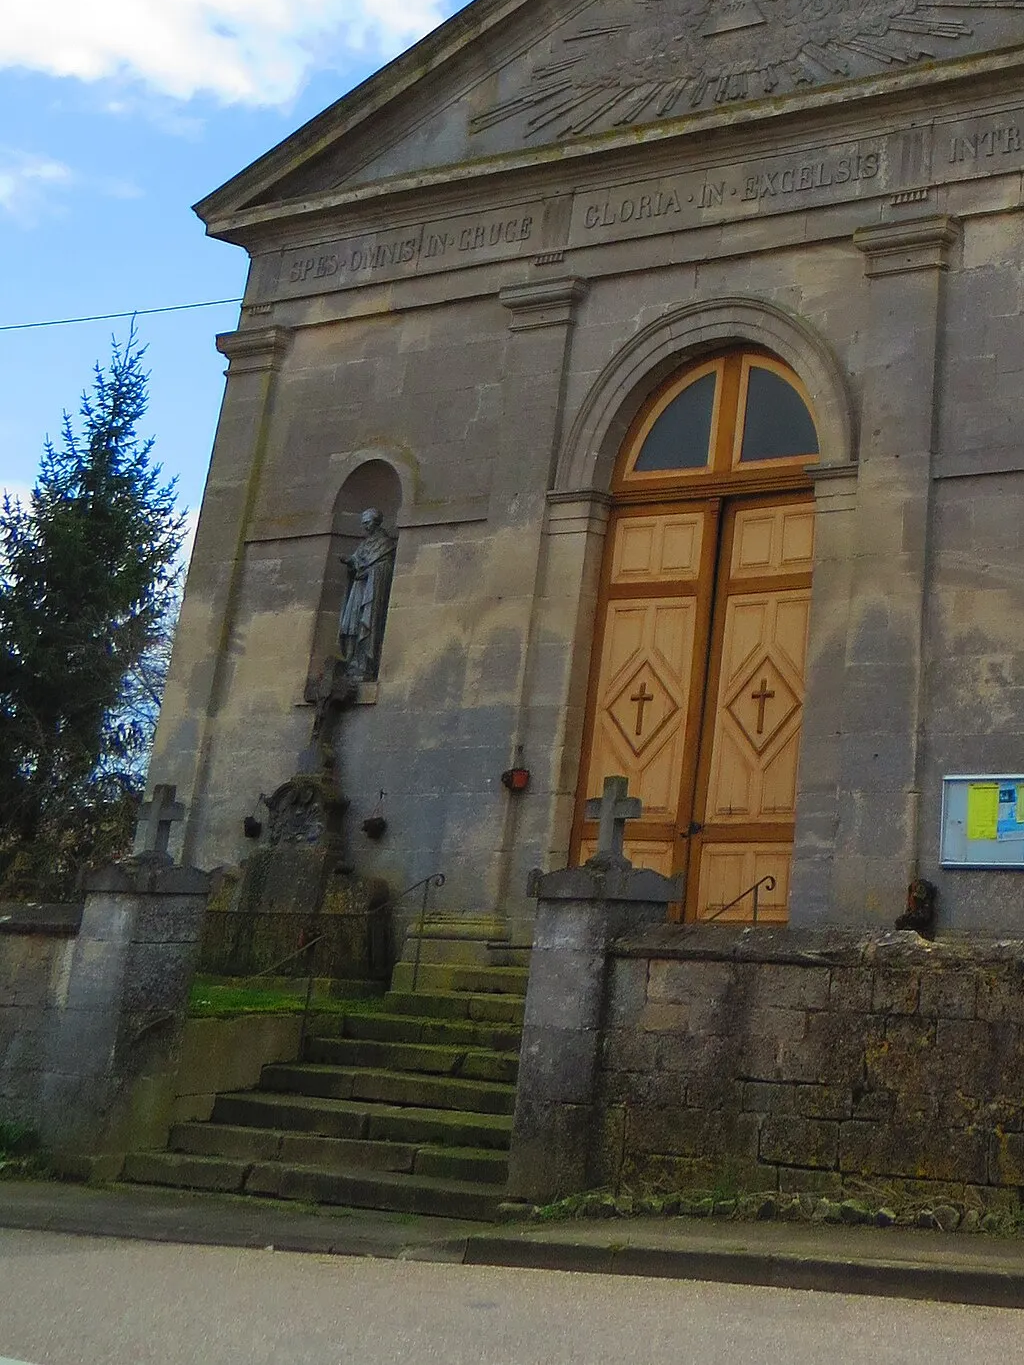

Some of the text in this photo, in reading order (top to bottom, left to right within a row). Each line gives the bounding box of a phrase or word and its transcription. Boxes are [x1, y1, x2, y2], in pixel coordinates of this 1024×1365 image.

[583, 152, 881, 230] GLORIA IN EXCELSIS
[289, 216, 533, 283] SPES OMNIS IN CRUCE
